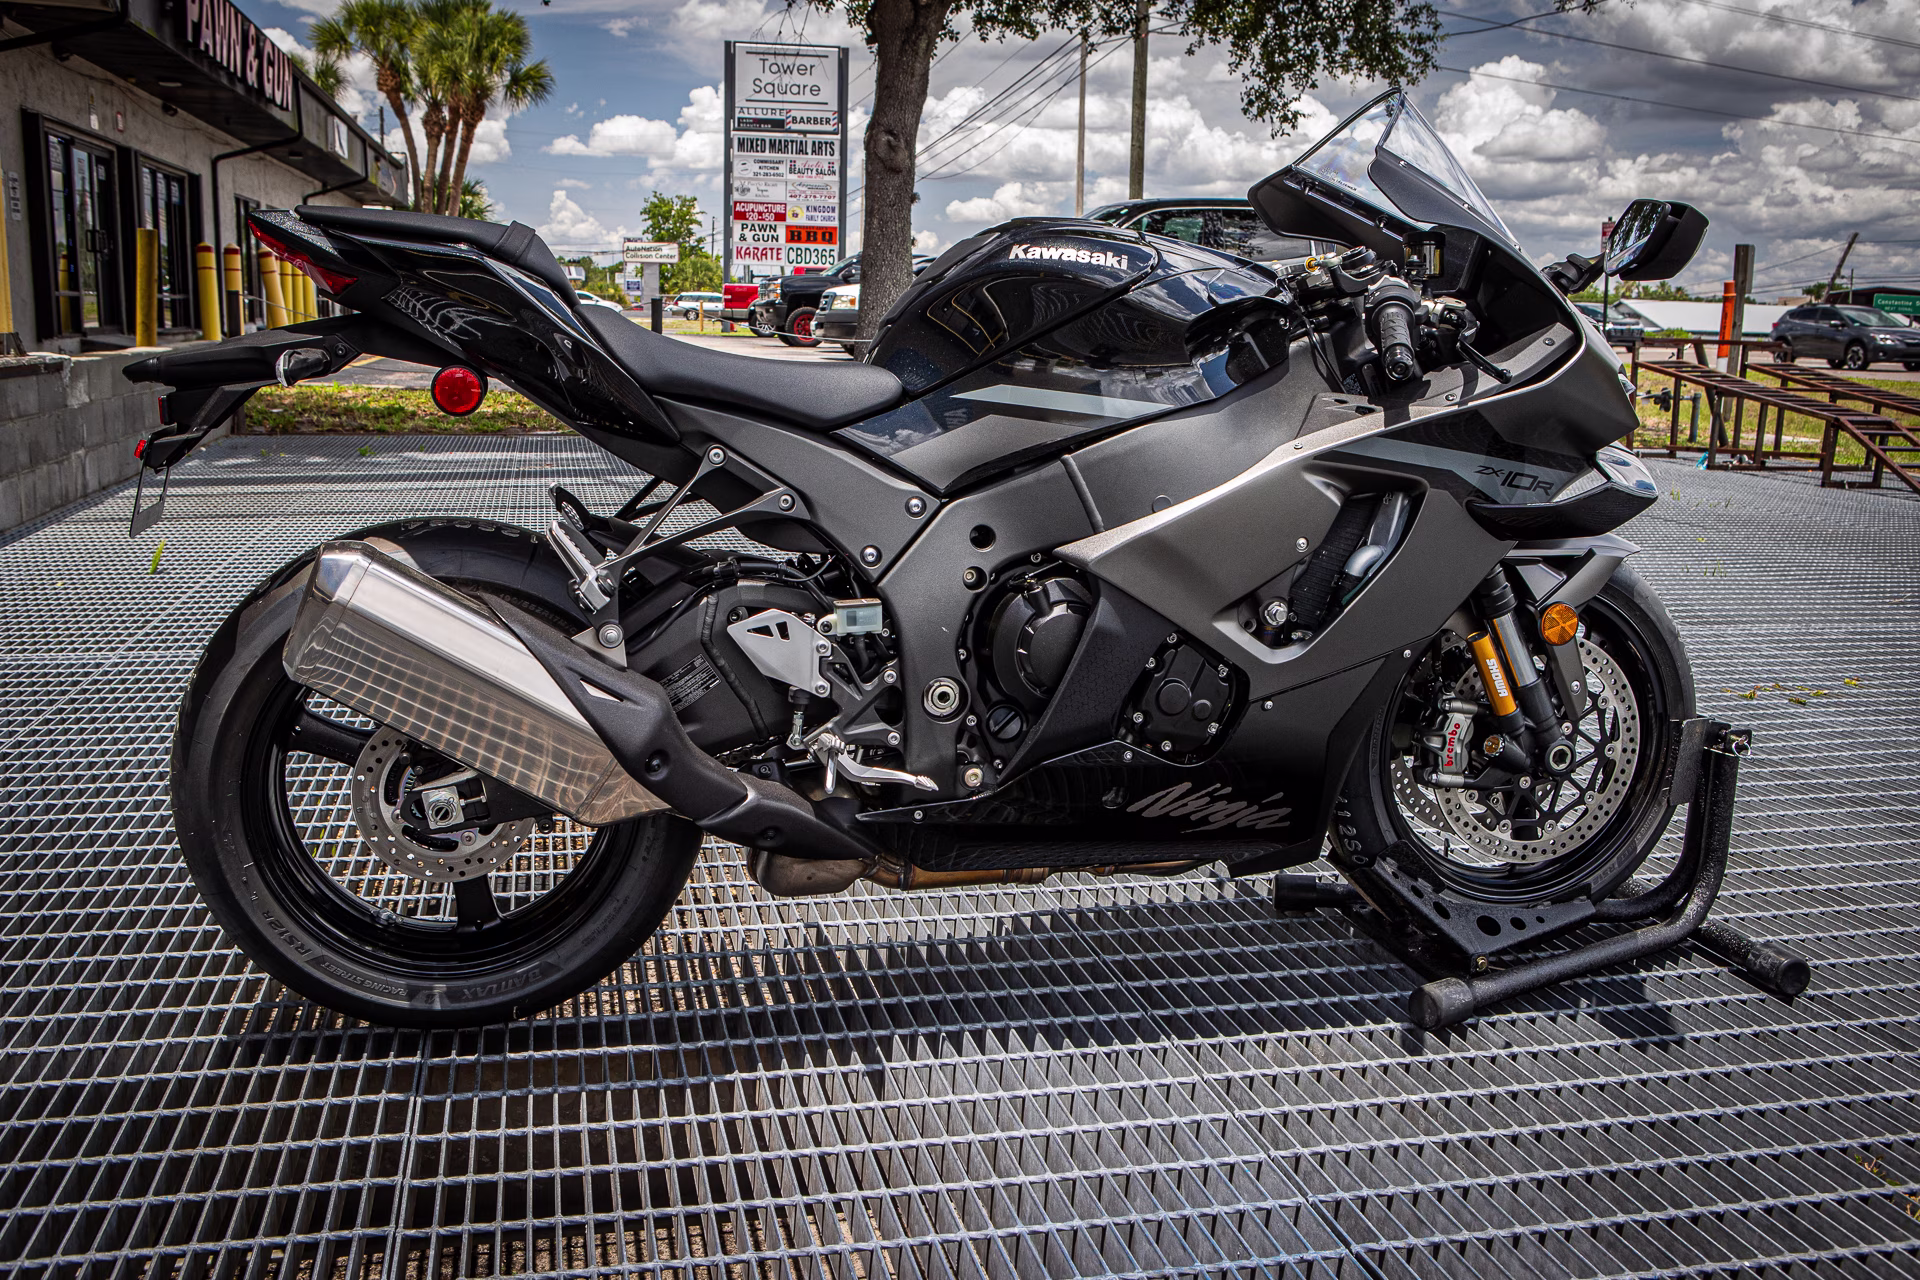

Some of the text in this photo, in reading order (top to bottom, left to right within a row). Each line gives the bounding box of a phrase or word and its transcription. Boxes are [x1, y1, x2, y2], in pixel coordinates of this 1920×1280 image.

[186, 0, 293, 112] PAWN & GUN
[759, 58, 815, 76] Tower
[753, 78, 821, 98] Square
[738, 107, 785, 117] ALLURE
[791, 116, 832, 126] BARBER
[737, 137, 835, 157] MIXED MARTIAL ARTS
[788, 167, 837, 177] BEAUTY SALON
[735, 203, 786, 213] ACUPUNCTURE
[805, 205, 836, 213] KINGDOM
[741, 223, 777, 233] PAWN
[790, 230, 833, 244] BBQ
[739, 233, 779, 243] & GUN
[736, 246, 782, 262] KARATE
[787, 247, 836, 266] CBD365
[1008, 244, 1129, 271] Kawasaki
[1473, 465, 1555, 497] ZX-10R
[1485, 658, 1509, 698] SHOWA
[1444, 722, 1461, 767] brembo
[1126, 781, 1292, 834] Ninja
[320, 961, 409, 997] RACING STREET
